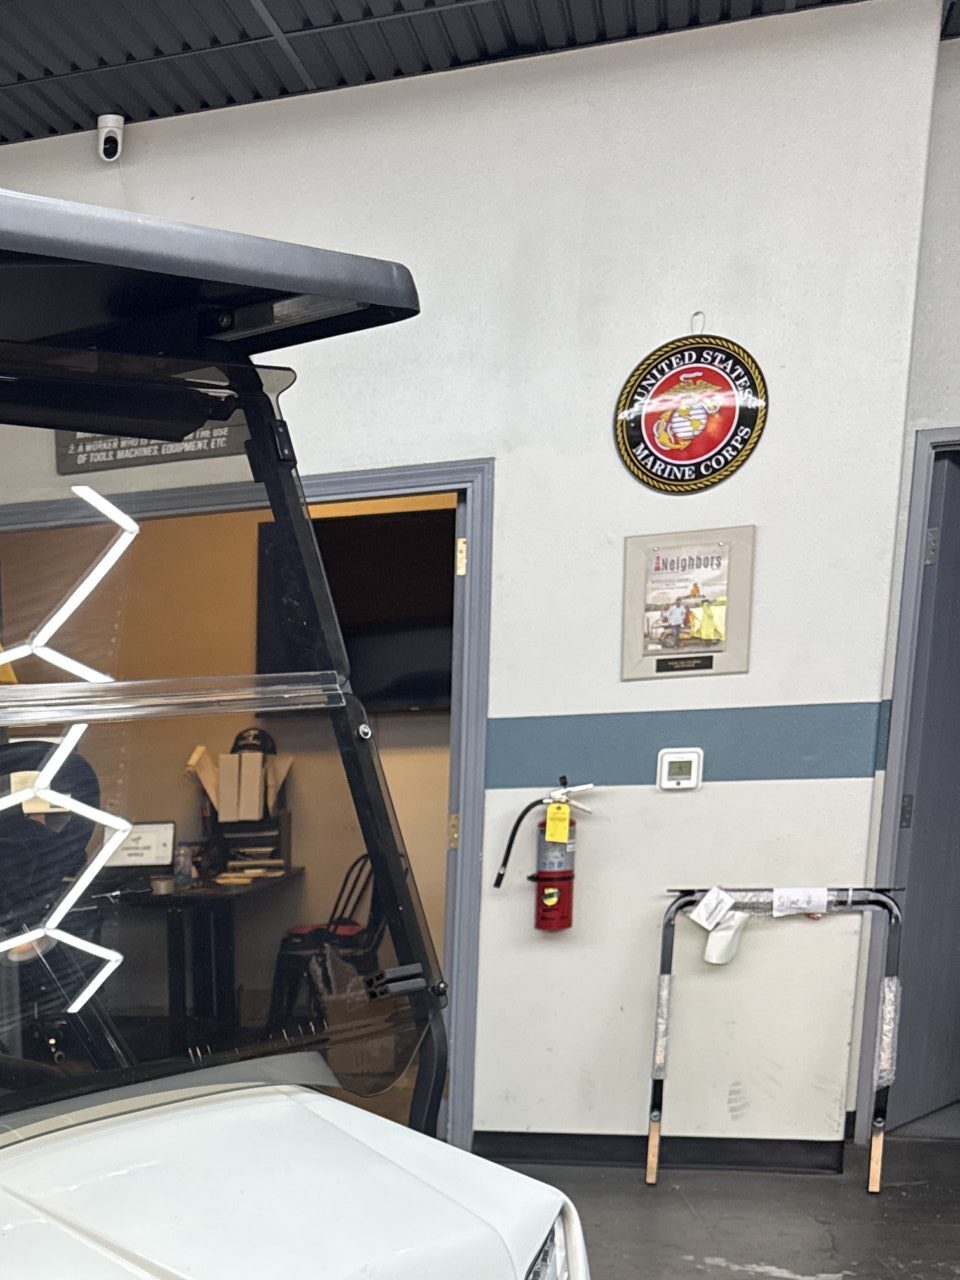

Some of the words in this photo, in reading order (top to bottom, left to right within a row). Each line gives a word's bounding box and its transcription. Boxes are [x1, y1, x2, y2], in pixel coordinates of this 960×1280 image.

[634, 350, 697, 402] UNITED
[701, 349, 754, 402] STATES
[212, 427, 230, 437] USE
[77, 453, 88, 465] OF
[632, 442, 696, 480] MARINE
[700, 426, 752, 476] CORPS
[661, 555, 722, 573] Neighbors
